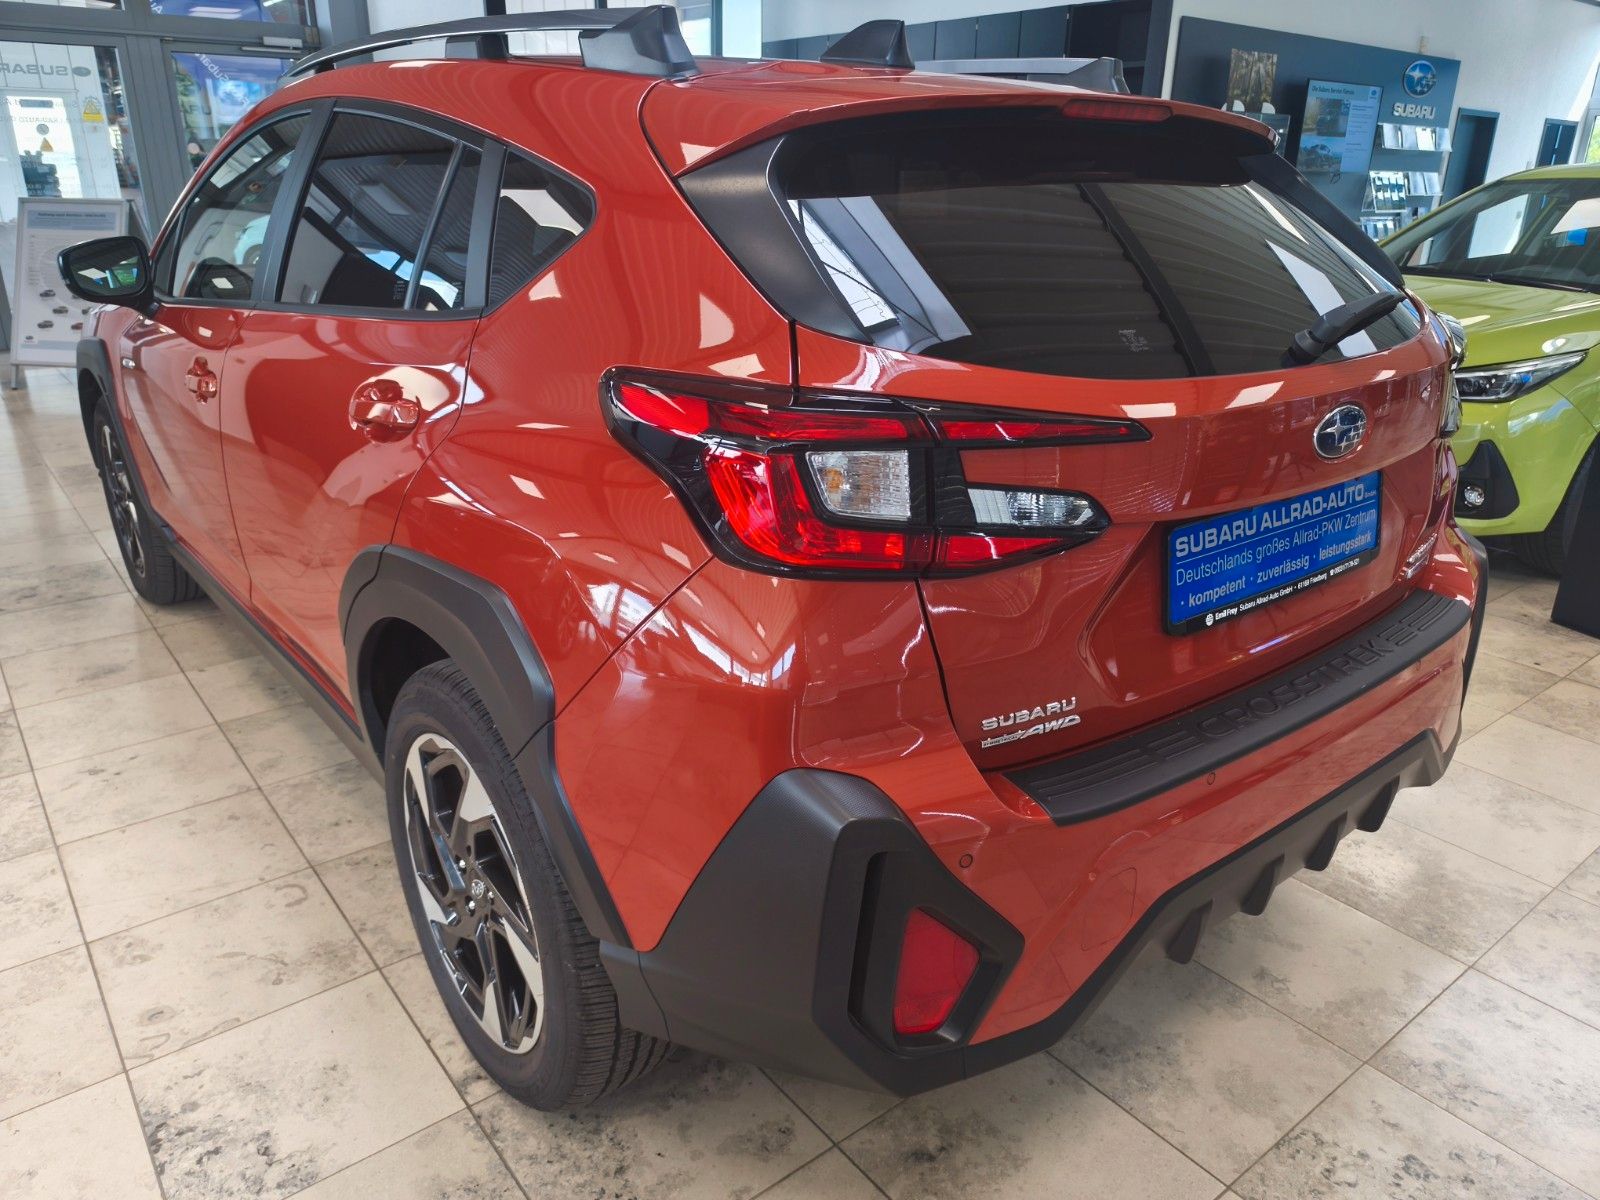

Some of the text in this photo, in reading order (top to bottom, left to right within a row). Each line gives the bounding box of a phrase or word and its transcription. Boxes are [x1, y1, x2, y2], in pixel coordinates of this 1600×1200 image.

[1392, 102, 1436, 120] SUBARU
[1175, 515, 1257, 558] SUBARU
[1260, 483, 1365, 532] ALLRAD-AUTO
[1176, 508, 1377, 586] Deutschlands großes Allrad-PKW Zentrum
[1188, 575, 1246, 608] kompetent
[1256, 553, 1310, 583] zuverlässig
[1319, 531, 1372, 560] leistungsstark
[1227, 606, 1238, 619] Frey
[981, 696, 1076, 731] SUBARU
[1198, 639, 1393, 736] CROSSTREK
[1020, 714, 1081, 740] AWD
